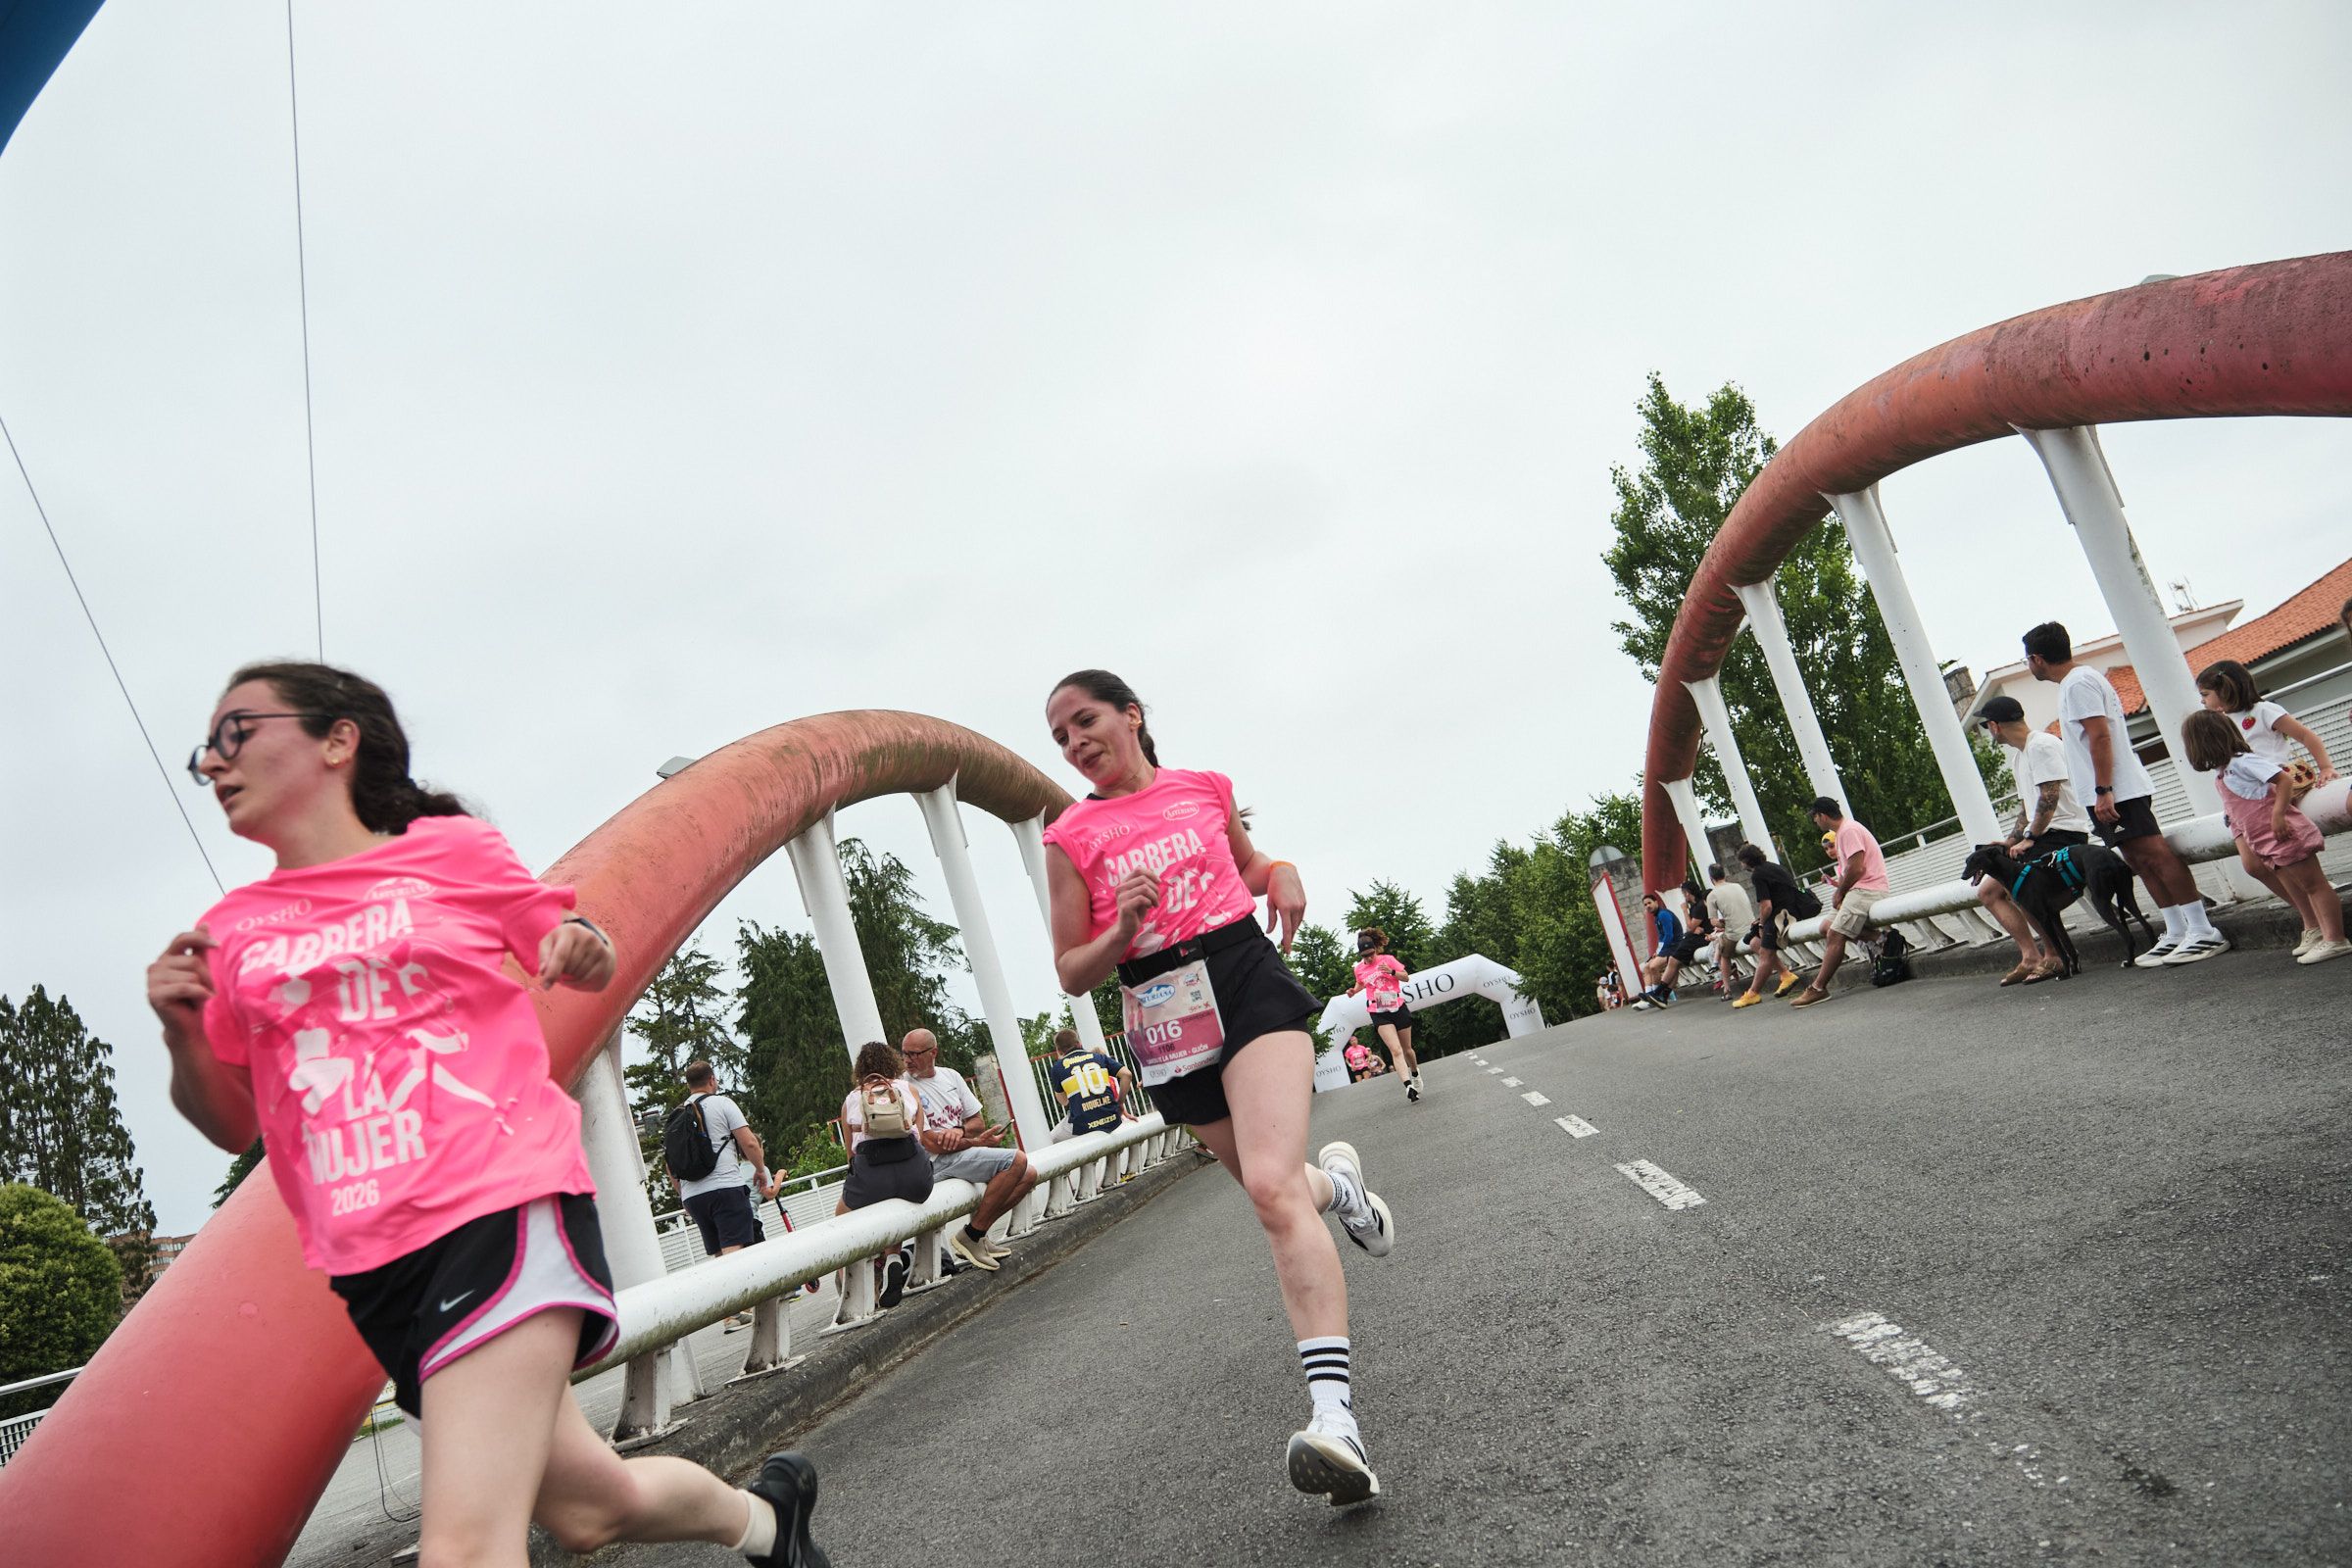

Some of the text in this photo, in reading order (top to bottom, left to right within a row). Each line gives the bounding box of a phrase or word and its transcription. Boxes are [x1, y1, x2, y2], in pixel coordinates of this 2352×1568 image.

[1089, 824, 1130, 851] OYSHO
[1166, 868, 1199, 913] DE
[235, 899, 312, 931] OYSHO
[336, 956, 397, 1022] DE
[1401, 974, 1454, 1004] SHO
[1483, 975, 1511, 988] OYSHO
[1510, 1007, 1536, 1020] OYSHO
[1146, 1019, 1183, 1045] 016
[1183, 1055, 1215, 1072] Santander
[1316, 1065, 1342, 1078] OYSHO
[1070, 1061, 1106, 1099] 10
[343, 1068, 389, 1121] LA
[1081, 1096, 1112, 1112] RIQUELME
[330, 1179, 380, 1217] 2026
